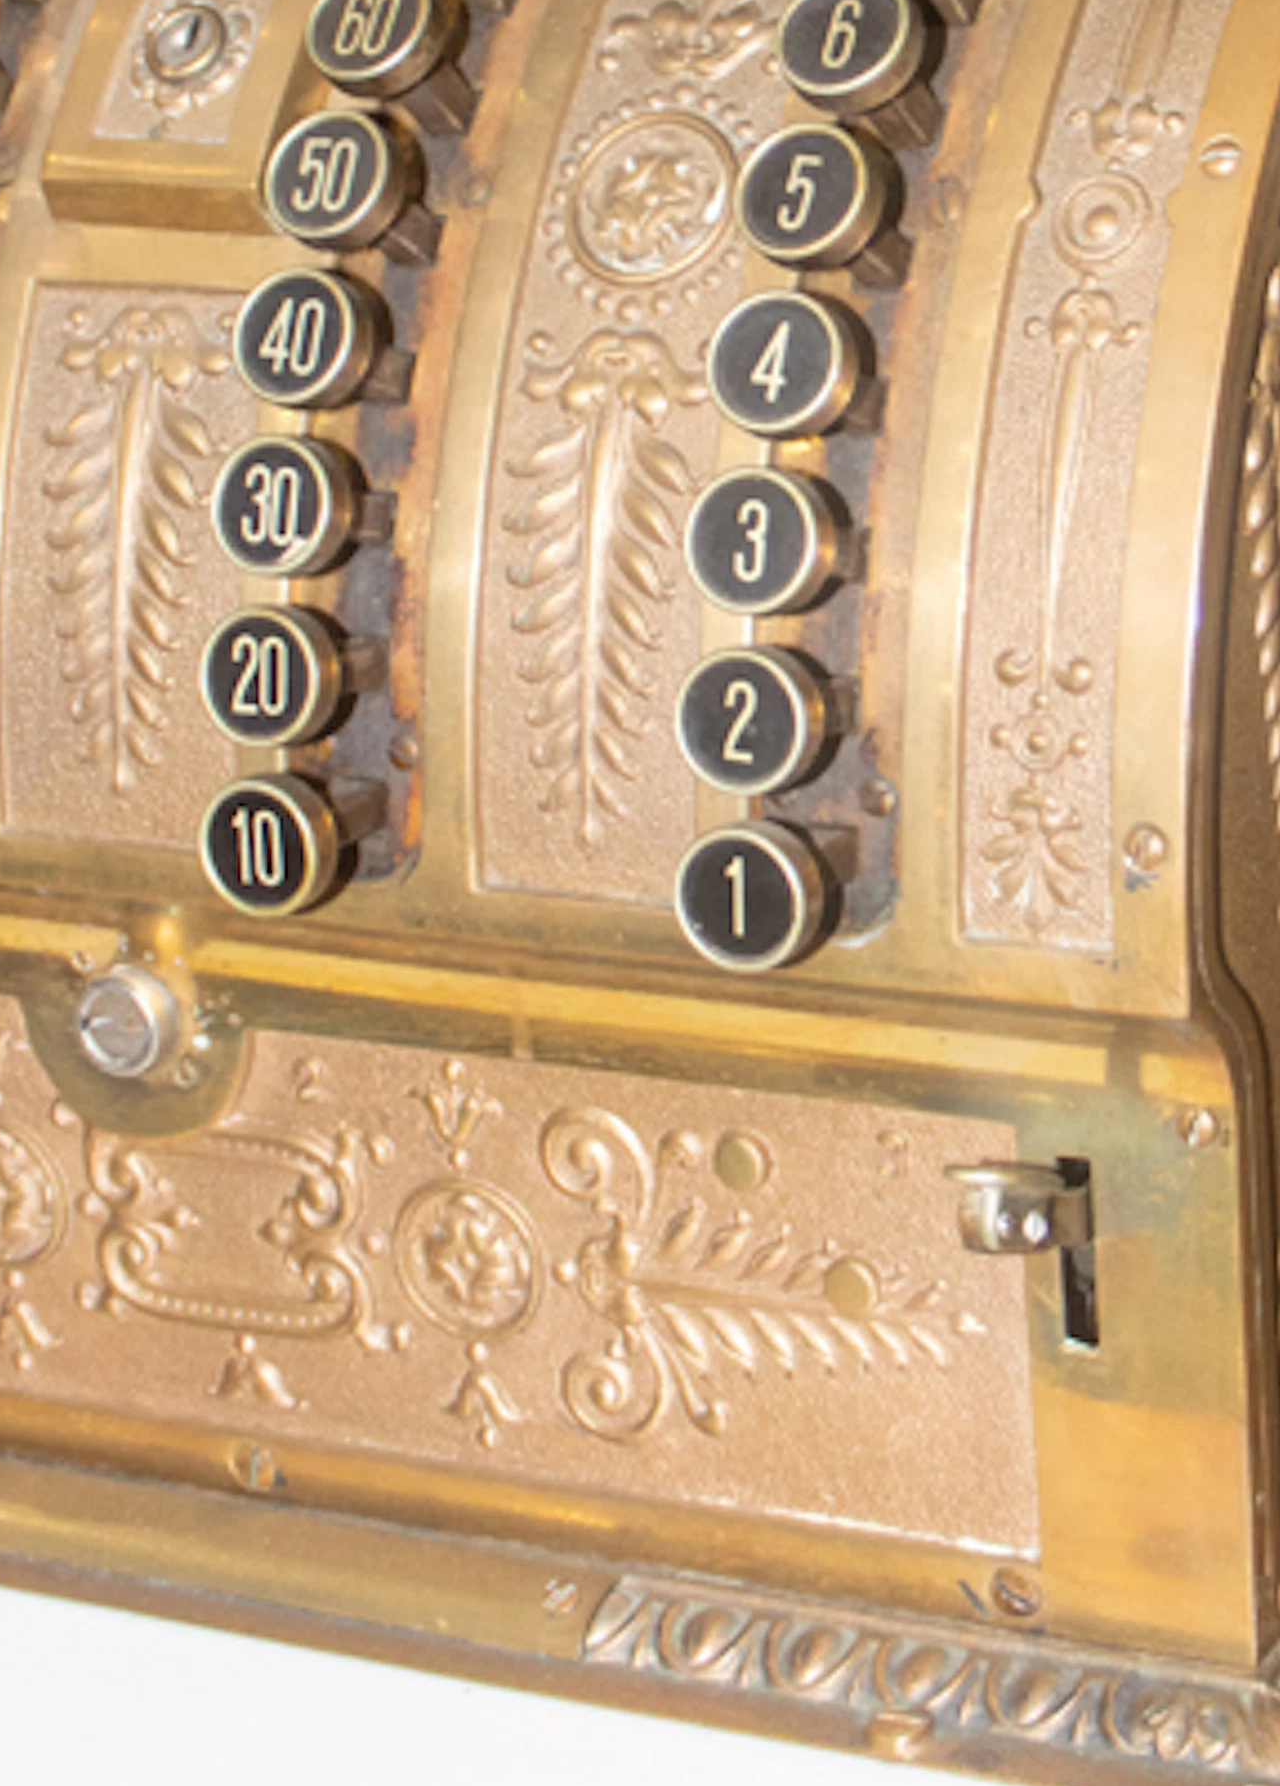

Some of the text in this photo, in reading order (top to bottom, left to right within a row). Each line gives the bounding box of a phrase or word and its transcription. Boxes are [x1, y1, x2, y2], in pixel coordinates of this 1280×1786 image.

[291, 137, 360, 213] 50
[776, 154, 824, 232] 5
[258, 297, 326, 377] 40
[750, 319, 791, 404] 4
[240, 463, 301, 546] 30
[732, 498, 770, 584] 3
[229, 634, 290, 716] 20
[721, 679, 759, 765] 2
[230, 807, 286, 888] 10
[722, 854, 746, 938] 1
